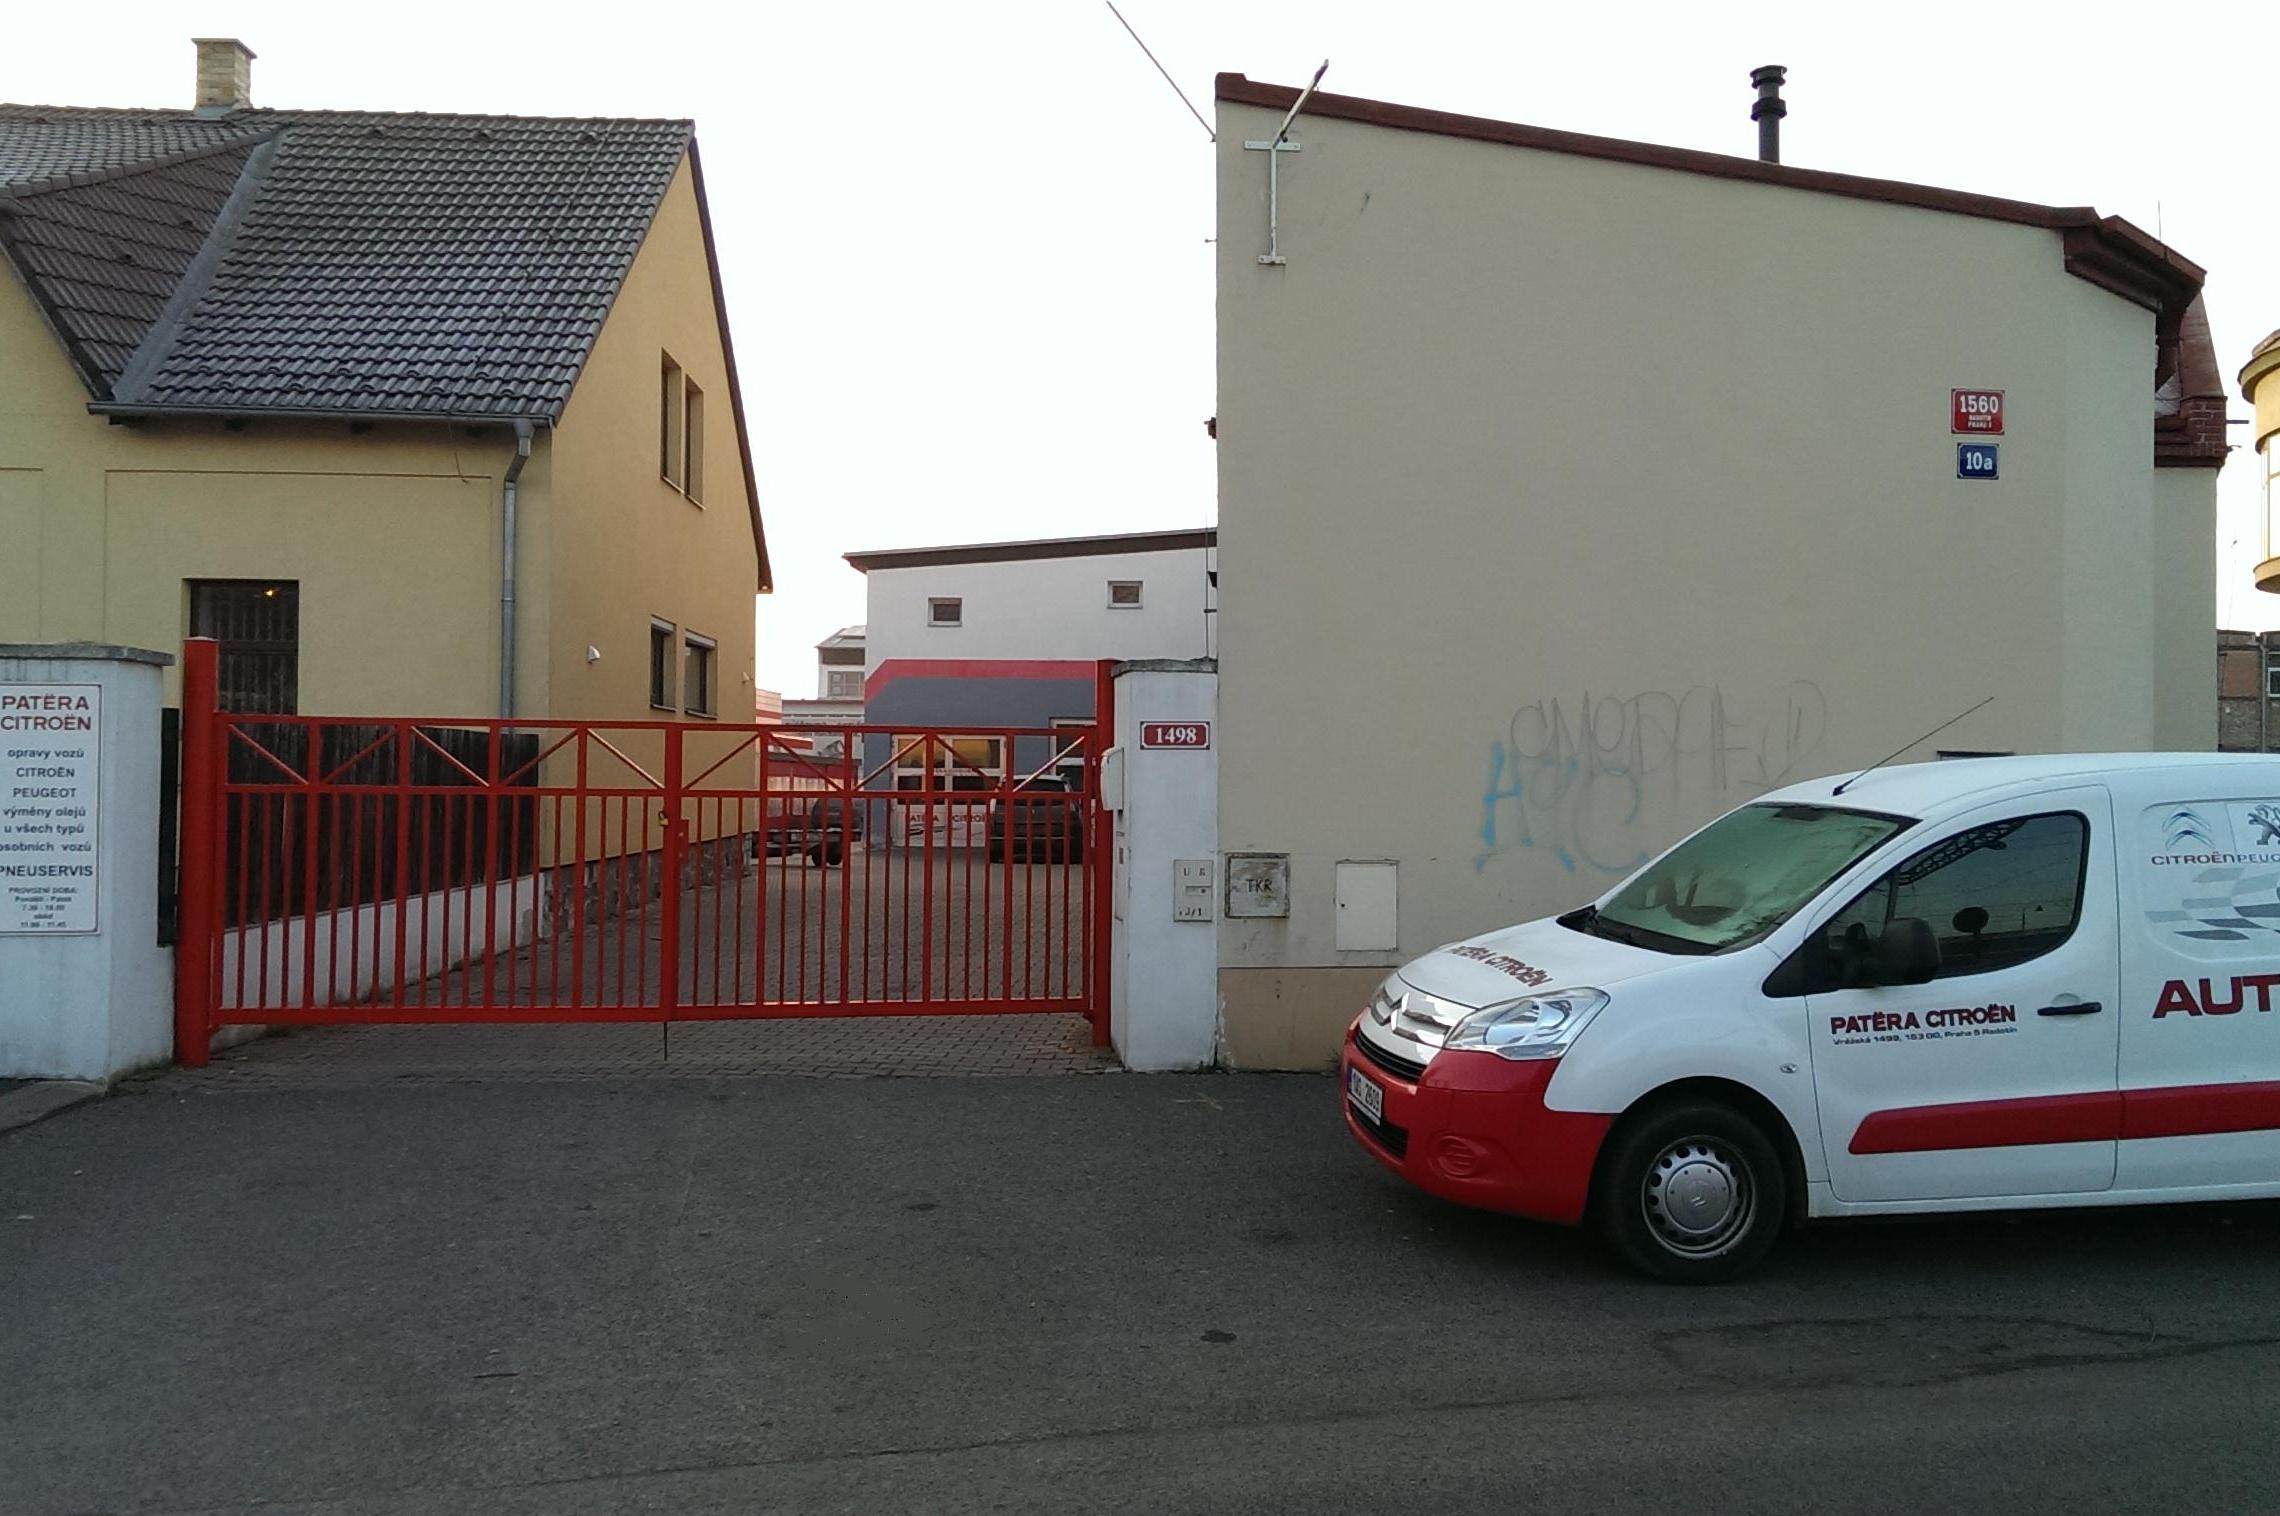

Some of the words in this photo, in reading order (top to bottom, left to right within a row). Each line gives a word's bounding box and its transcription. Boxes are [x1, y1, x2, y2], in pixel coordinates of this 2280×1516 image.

[1960, 395, 1999, 413] 1560
[1966, 452, 1993, 470] 10a
[2, 693, 89, 710] PATËRA
[0, 713, 91, 730] CITROËN
[1156, 727, 1197, 743] 1498
[7, 749, 50, 760] opravy
[16, 766, 75, 777] CITROËN
[13, 787, 76, 798] PEUGEOT
[4, 825, 12, 833] u
[16, 823, 53, 834] všech
[1246, 878, 1273, 893] TKR
[1830, 1011, 1920, 1035] PATËRA
[1925, 1003, 2016, 1028] CITROËN
[1944, 1030, 1972, 1038] Praha
